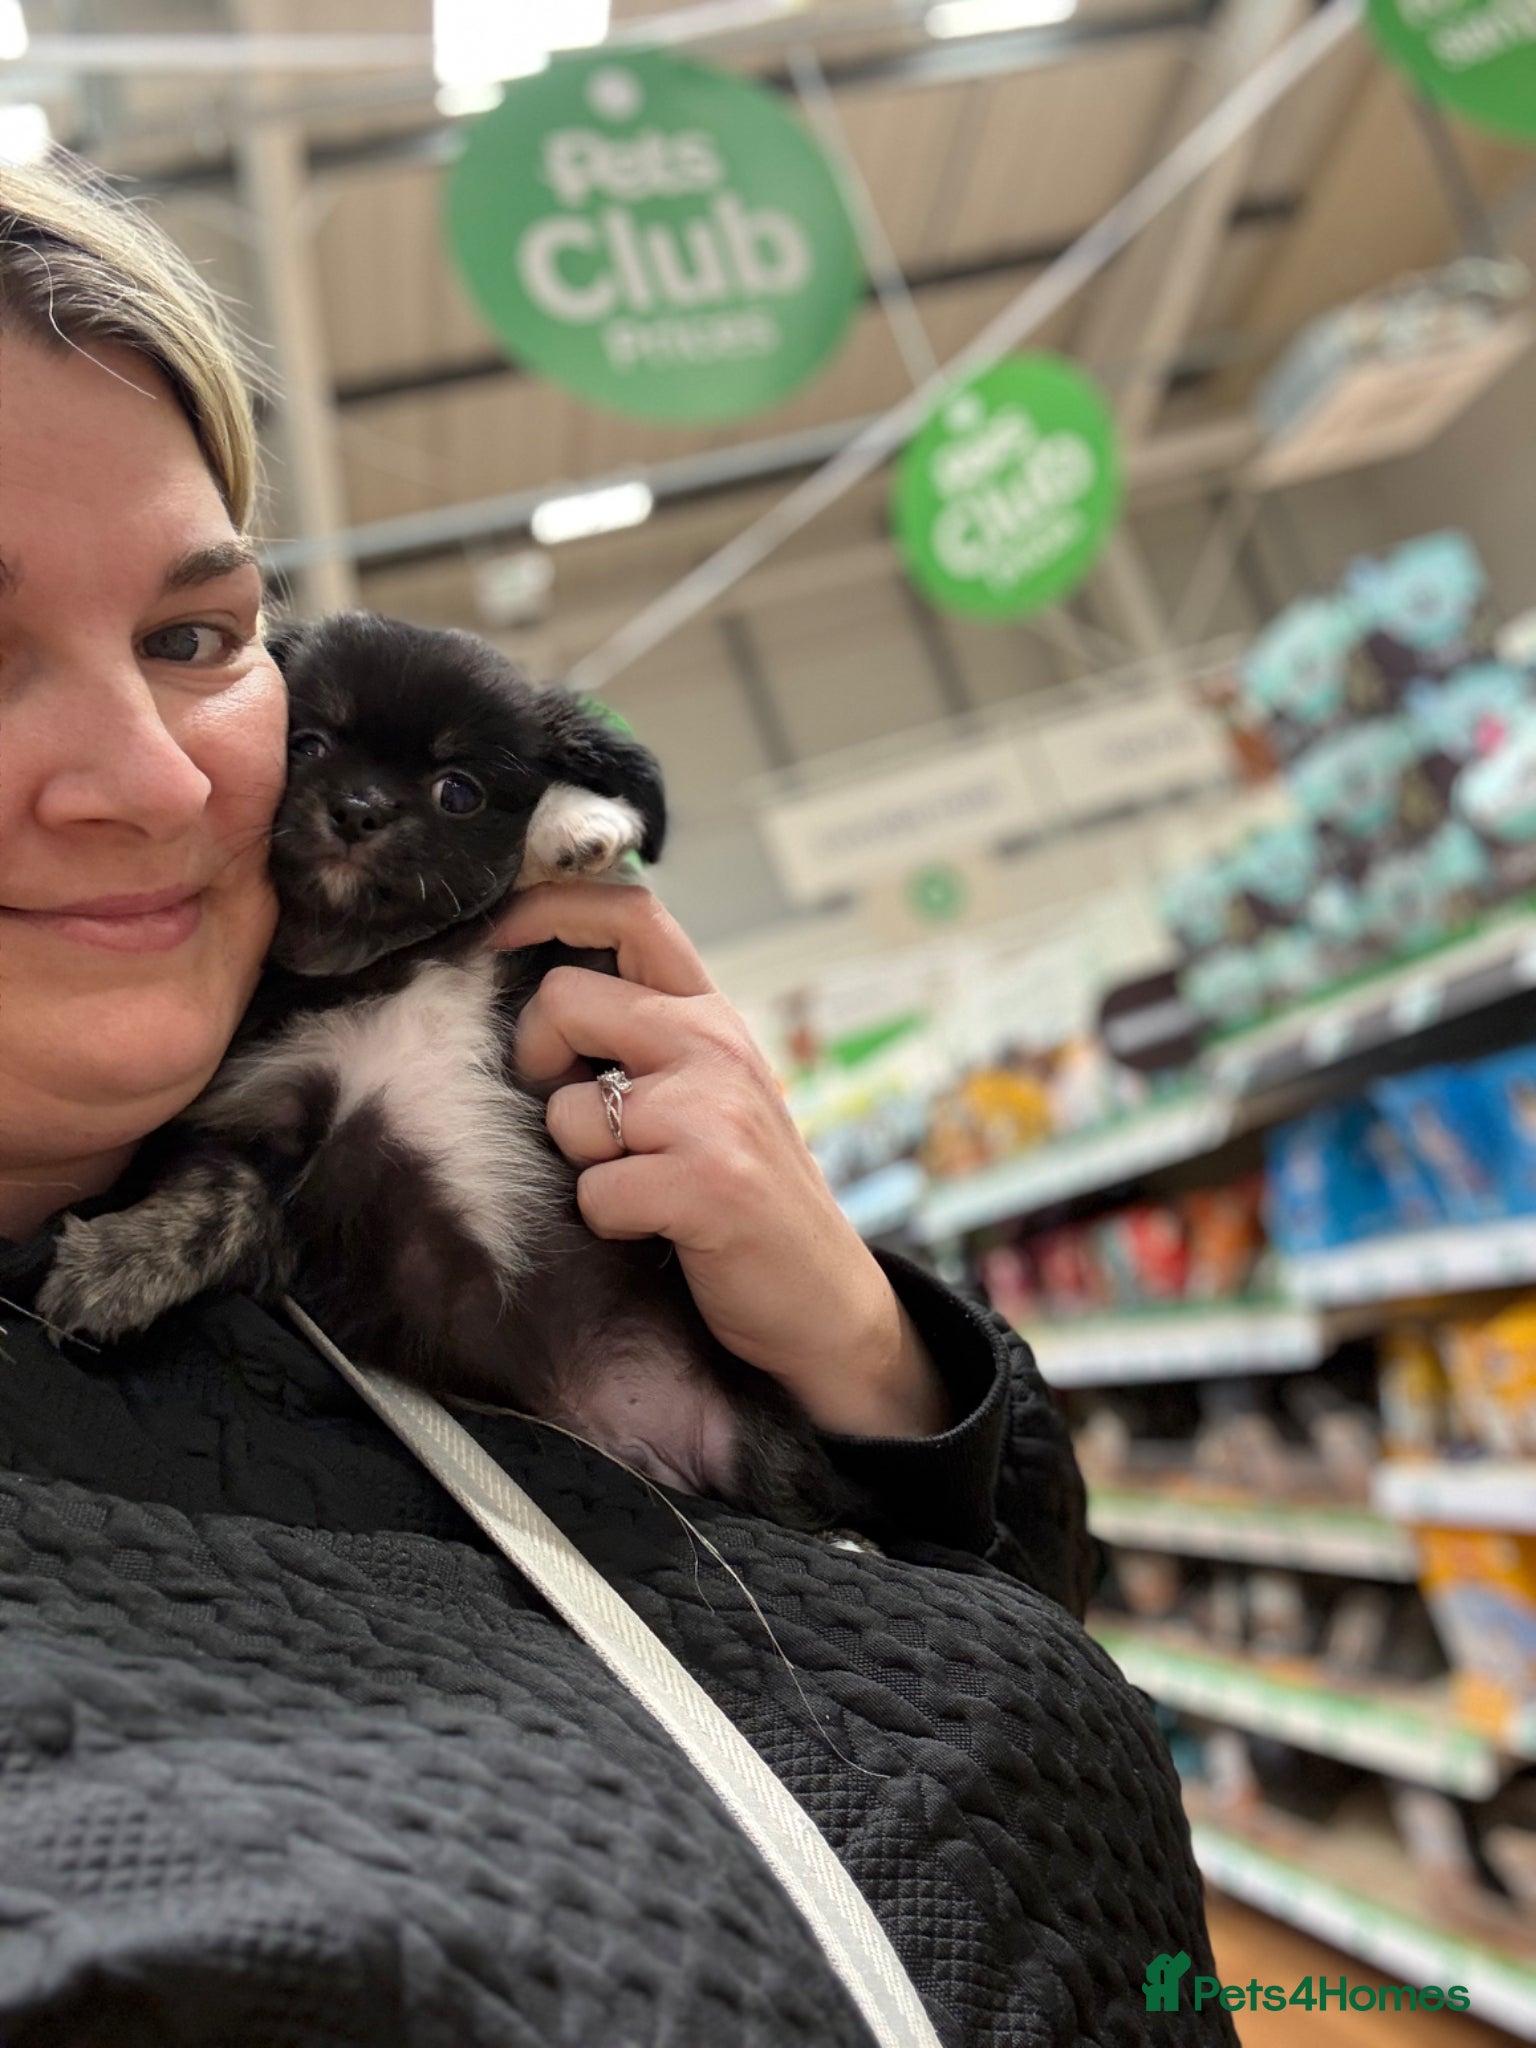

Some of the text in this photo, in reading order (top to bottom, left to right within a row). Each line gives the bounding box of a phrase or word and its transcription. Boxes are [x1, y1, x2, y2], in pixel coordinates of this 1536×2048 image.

[546, 130, 720, 203] Pets
[521, 196, 810, 322] Club
[932, 435, 1092, 577] Club
